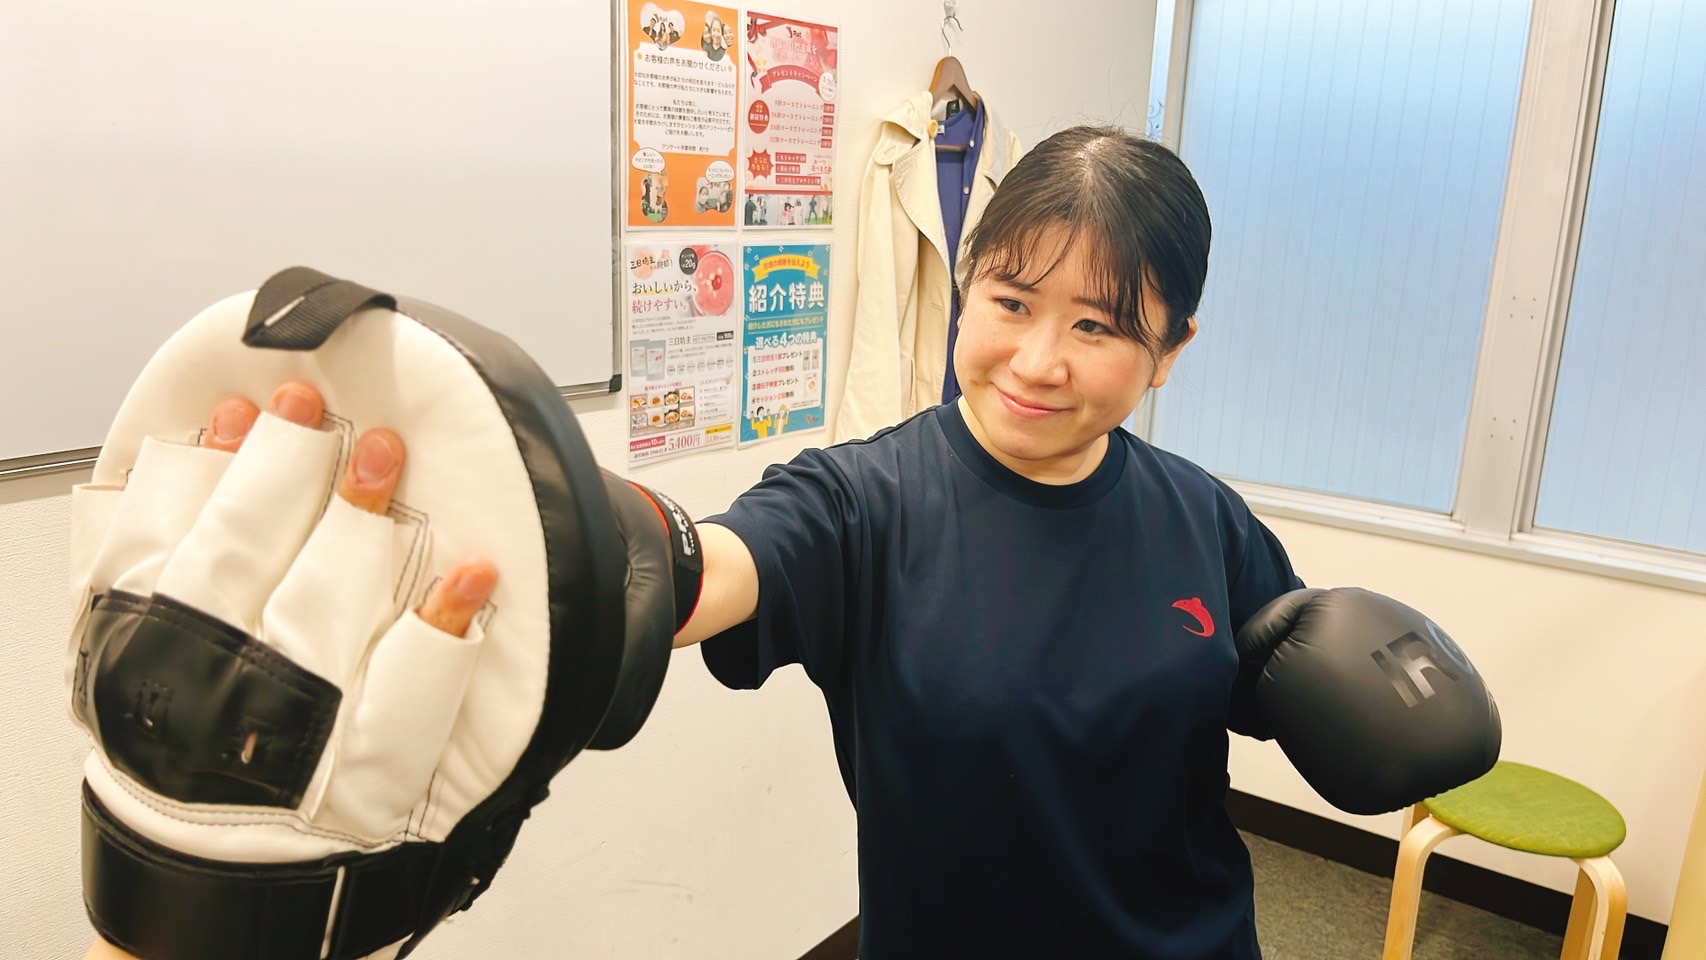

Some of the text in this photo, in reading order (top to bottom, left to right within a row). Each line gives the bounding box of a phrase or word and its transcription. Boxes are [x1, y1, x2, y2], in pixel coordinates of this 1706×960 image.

[645, 54, 727, 72] お客様の声をお聞かせください
[632, 280, 697, 294] おいしいから、
[749, 281, 824, 313] 紹介特典
[632, 299, 687, 314] 続けやすい。
[755, 331, 817, 350] 選べる4つの特典
